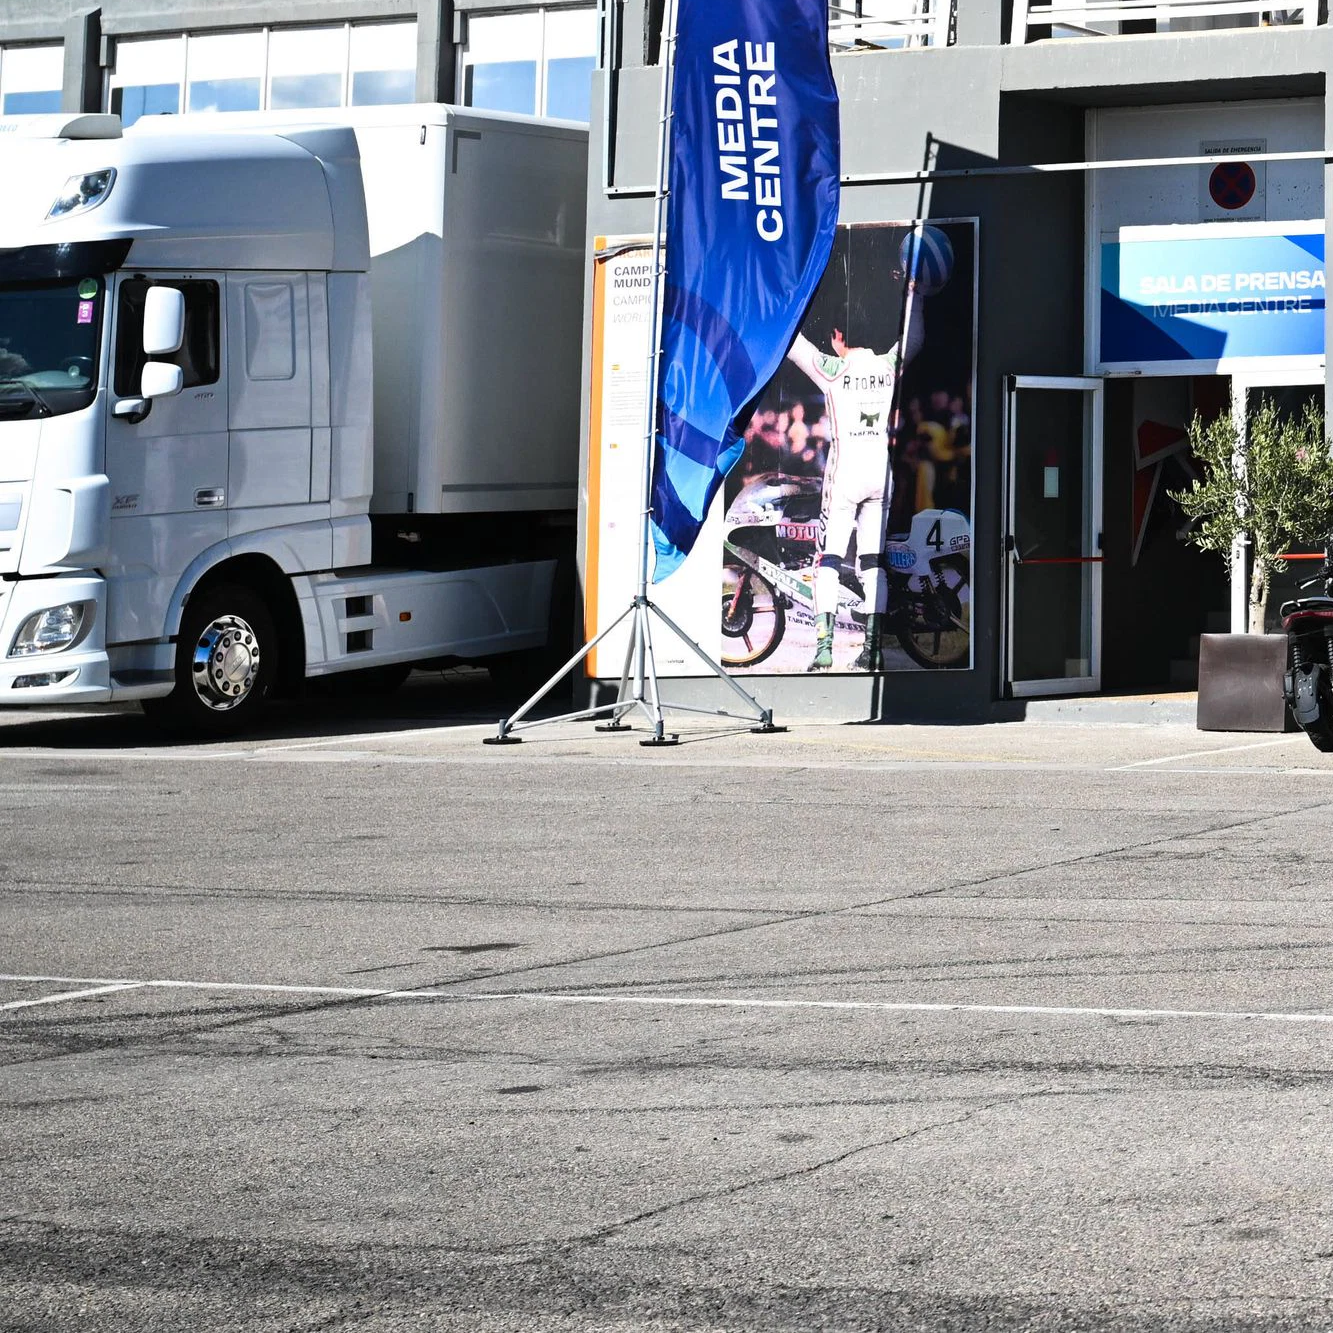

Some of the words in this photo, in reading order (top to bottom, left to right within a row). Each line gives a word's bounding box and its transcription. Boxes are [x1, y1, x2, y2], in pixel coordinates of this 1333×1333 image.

[713, 39, 749, 200] MEDIA
[745, 41, 784, 242] CENTRE
[614, 278, 651, 288] MUND
[1140, 274, 1198, 294] SALA
[1201, 273, 1232, 293] DE
[1235, 270, 1326, 291] PRENSA
[1153, 297, 1222, 318] MEDIA
[1225, 295, 1313, 315] CENTRE
[776, 526, 816, 539] MOTU
[926, 519, 944, 552] 4
